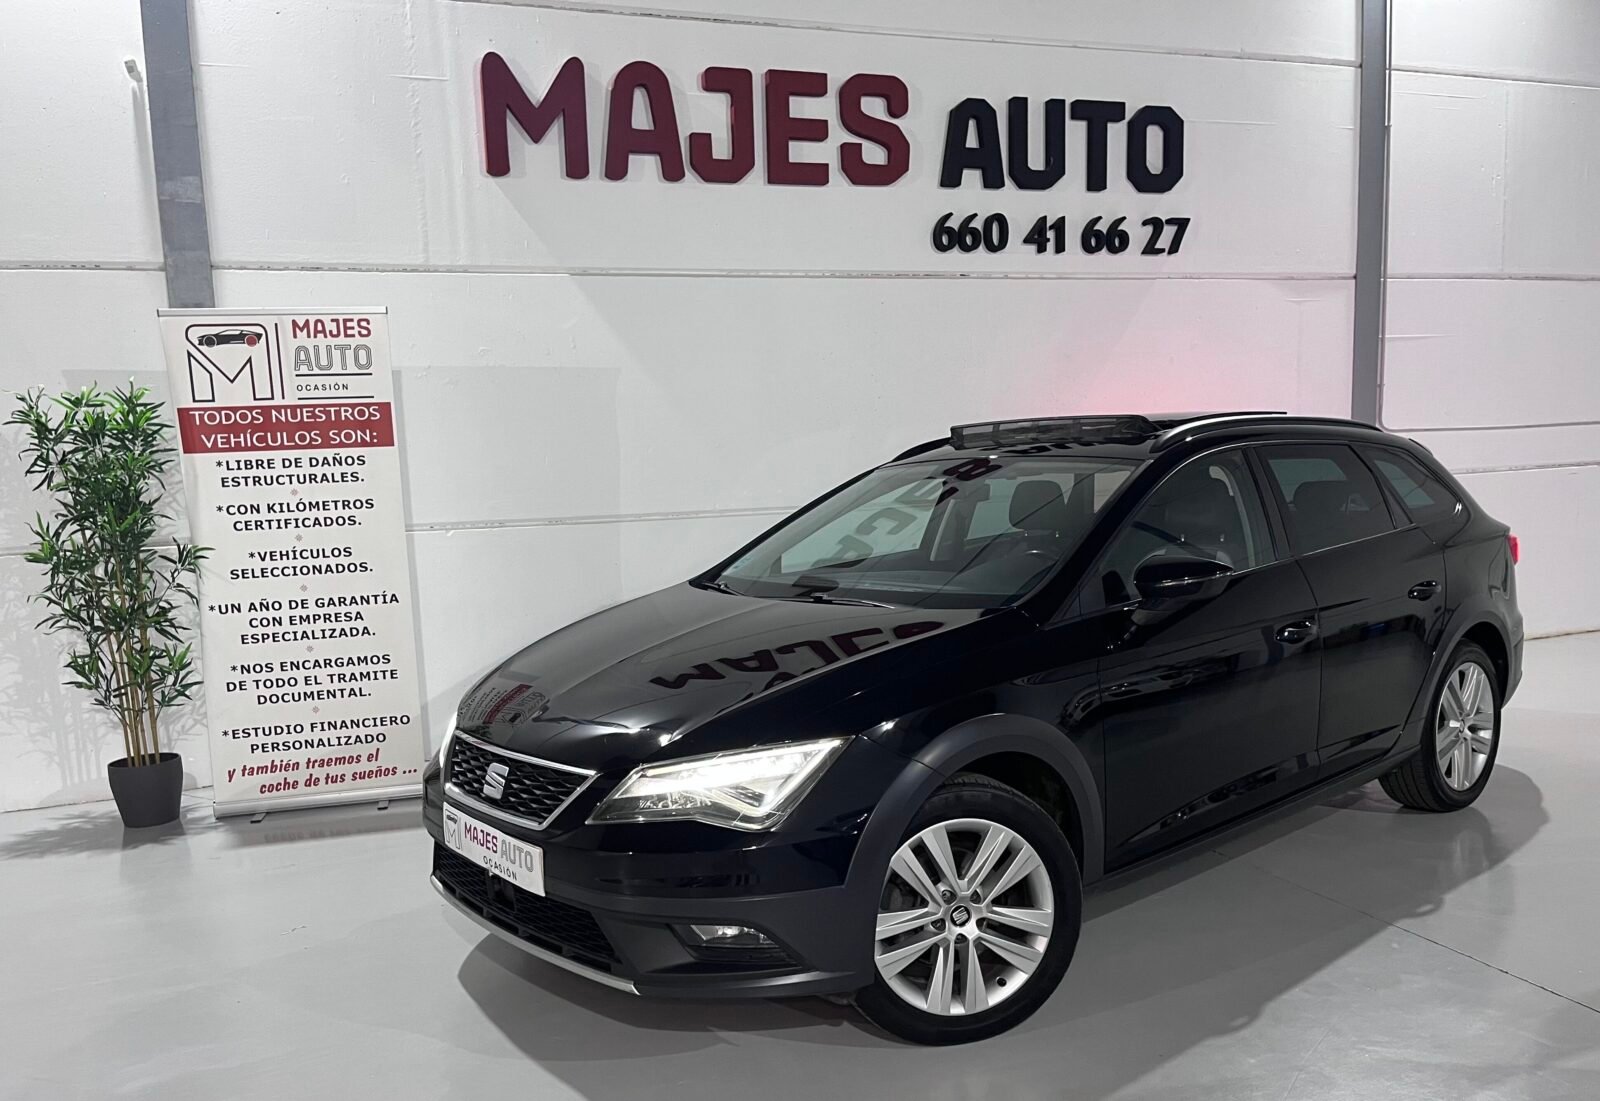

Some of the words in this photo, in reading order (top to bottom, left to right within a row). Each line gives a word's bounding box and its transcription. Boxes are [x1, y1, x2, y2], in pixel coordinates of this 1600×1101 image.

[480, 50, 910, 187] MAJES
[939, 95, 1184, 194] AUTO
[932, 211, 1009, 255] 660
[1022, 214, 1067, 255] 41
[1080, 214, 1130, 255] 66
[1140, 215, 1191, 256] 27
[291, 318, 372, 339] MAJES
[294, 344, 373, 371] AUTO
[296, 382, 349, 392] OCASIÓN
[189, 409, 264, 426] TODOS
[271, 405, 381, 423] NUESTROS
[200, 429, 322, 449] VEHÍCULOS
[329, 429, 378, 445] SON:
[281, 457, 303, 469] DE
[309, 453, 366, 468] DAÑOS
[220, 472, 365, 488] ESTRUCTURALES.
[267, 498, 375, 514] KILÓMETROS
[233, 515, 362, 532] CERTIFICADOS.
[230, 562, 374, 580] SELECCIONADOS.
[247, 598, 283, 613] AÑO
[288, 599, 309, 611] DE
[314, 591, 400, 608] GARANTÍA
[249, 615, 283, 629] CON
[289, 611, 365, 626] EMPRESA
[240, 626, 376, 645] ESPECIALIZADA.
[279, 654, 391, 672] ENCARGAMOS
[226, 680, 248, 693] DE
[252, 677, 298, 691] TODO
[304, 673, 323, 687] EL
[327, 669, 399, 685] TRAMITE
[257, 687, 372, 705] DOCUMENTAL.
[310, 714, 411, 733] FINANCIERO
[250, 732, 387, 754] PERSONALIZADO
[227, 769, 236, 783] y
[241, 759, 300, 778] también
[305, 752, 362, 768] traemos
[366, 748, 380, 762] el
[259, 776, 299, 795] coche
[304, 774, 321, 788] de
[324, 769, 346, 785] tus
[351, 765, 398, 782] sueños
[464, 821, 498, 854] MAJES
[501, 838, 533, 873] AUTO
[483, 855, 518, 881] OCASIÓN
